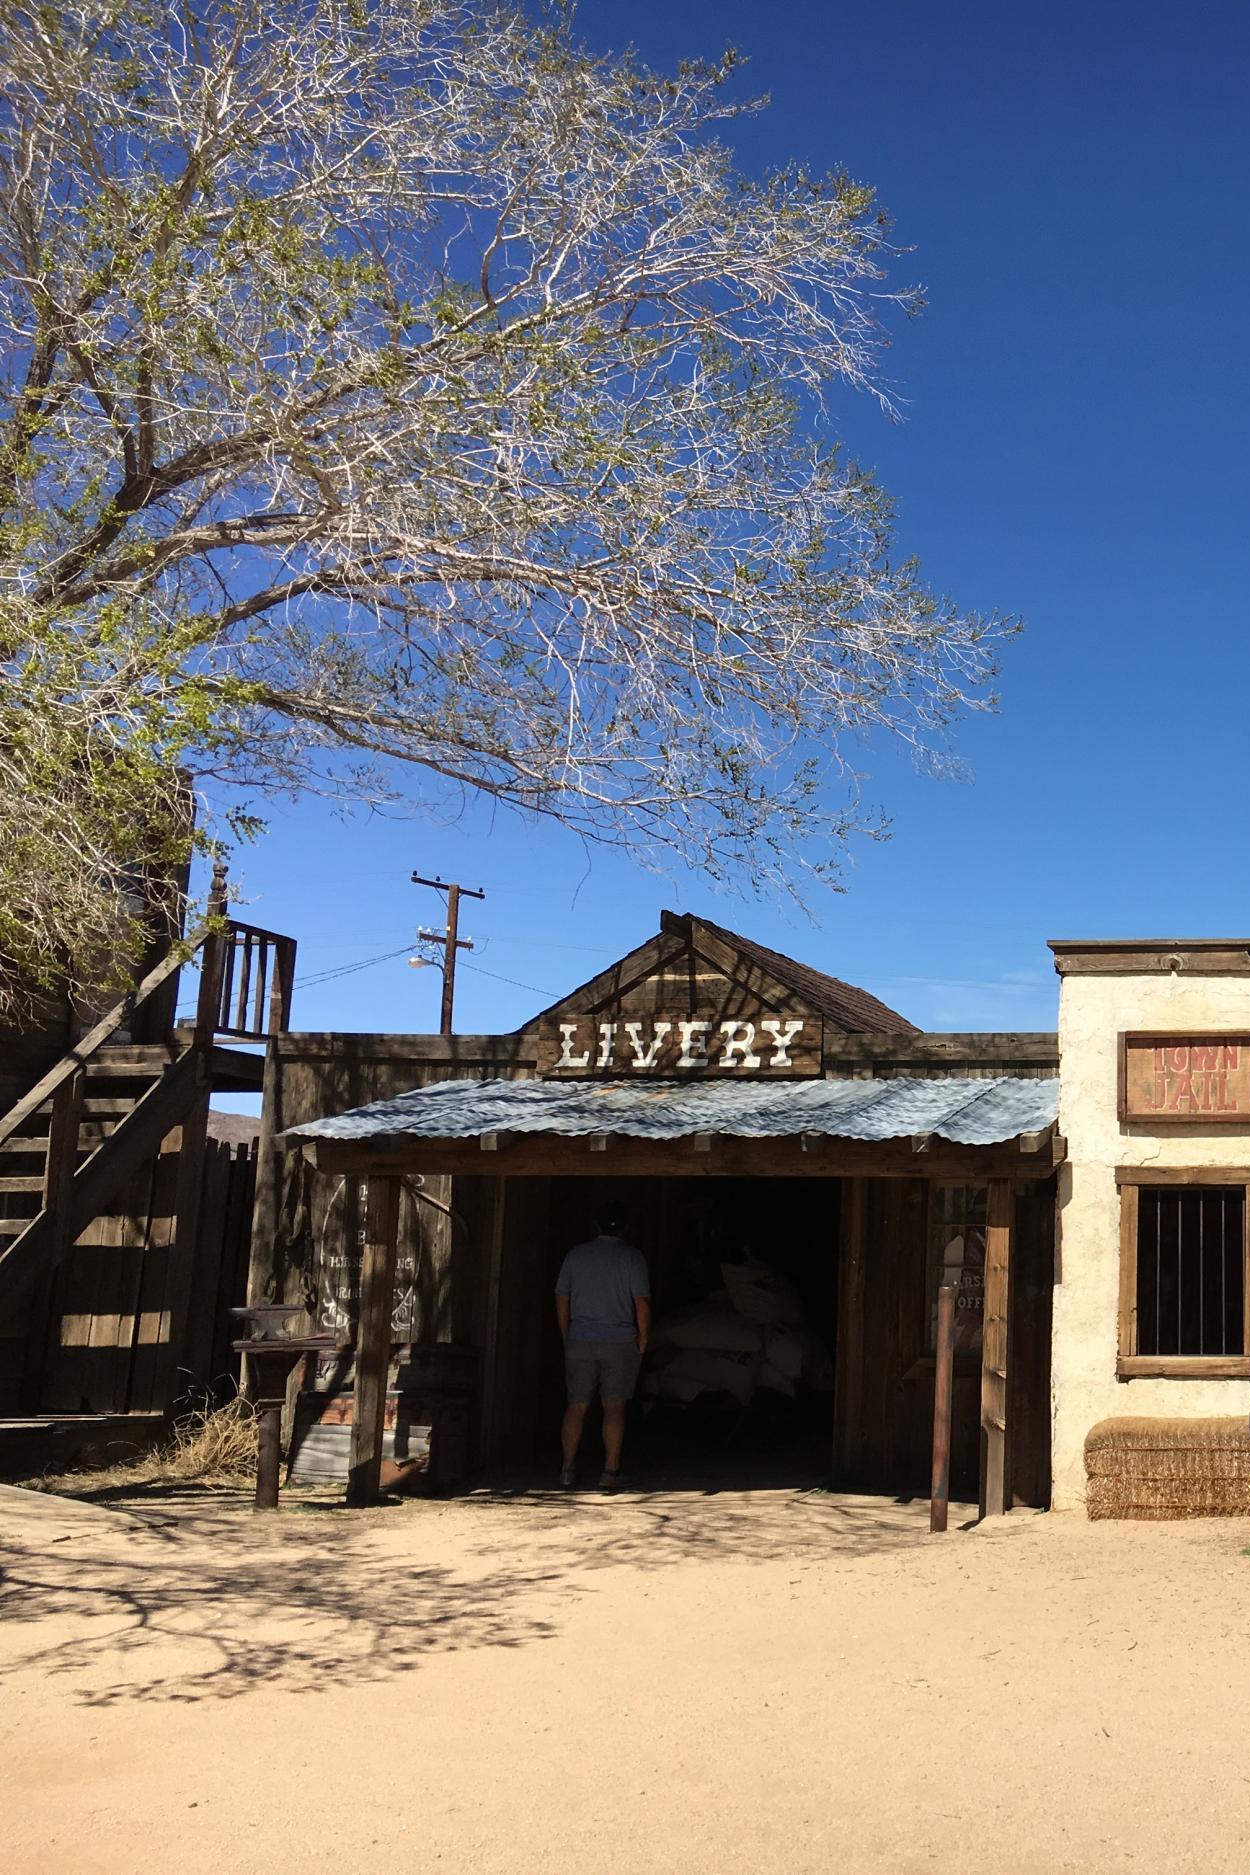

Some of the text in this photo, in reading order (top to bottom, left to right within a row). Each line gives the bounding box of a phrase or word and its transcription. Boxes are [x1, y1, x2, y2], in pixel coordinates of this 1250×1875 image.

[555, 1020, 803, 1068] LIVERY
[1147, 1041, 1240, 1073] TOWN
[1144, 1073, 1239, 1112] JAIL
[957, 1296, 984, 1309] OFF
